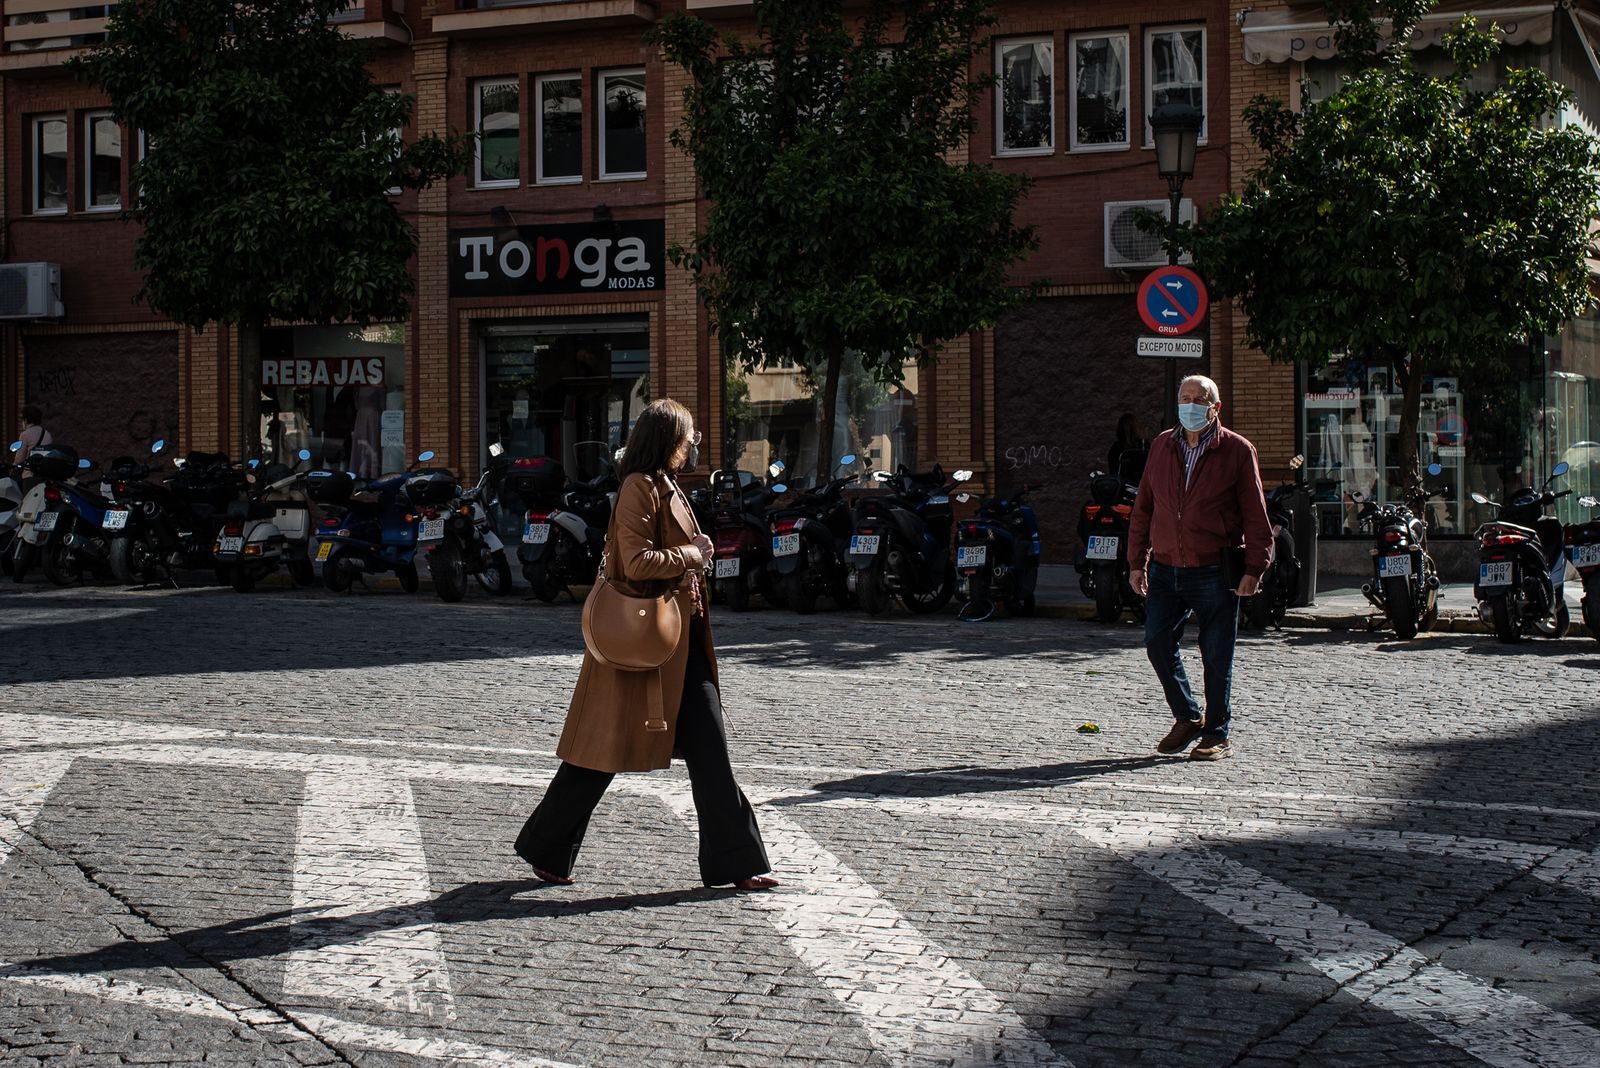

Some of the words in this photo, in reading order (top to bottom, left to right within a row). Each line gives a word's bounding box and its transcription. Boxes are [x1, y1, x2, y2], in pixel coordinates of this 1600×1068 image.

[459, 234, 651, 288] Tonga
[608, 276, 655, 289] MODAS
[1139, 342, 1173, 351] EXCEPTO
[1174, 343, 1201, 352] MOTOS
[718, 566, 738, 576] 0757
[1387, 565, 1404, 576] KCS
